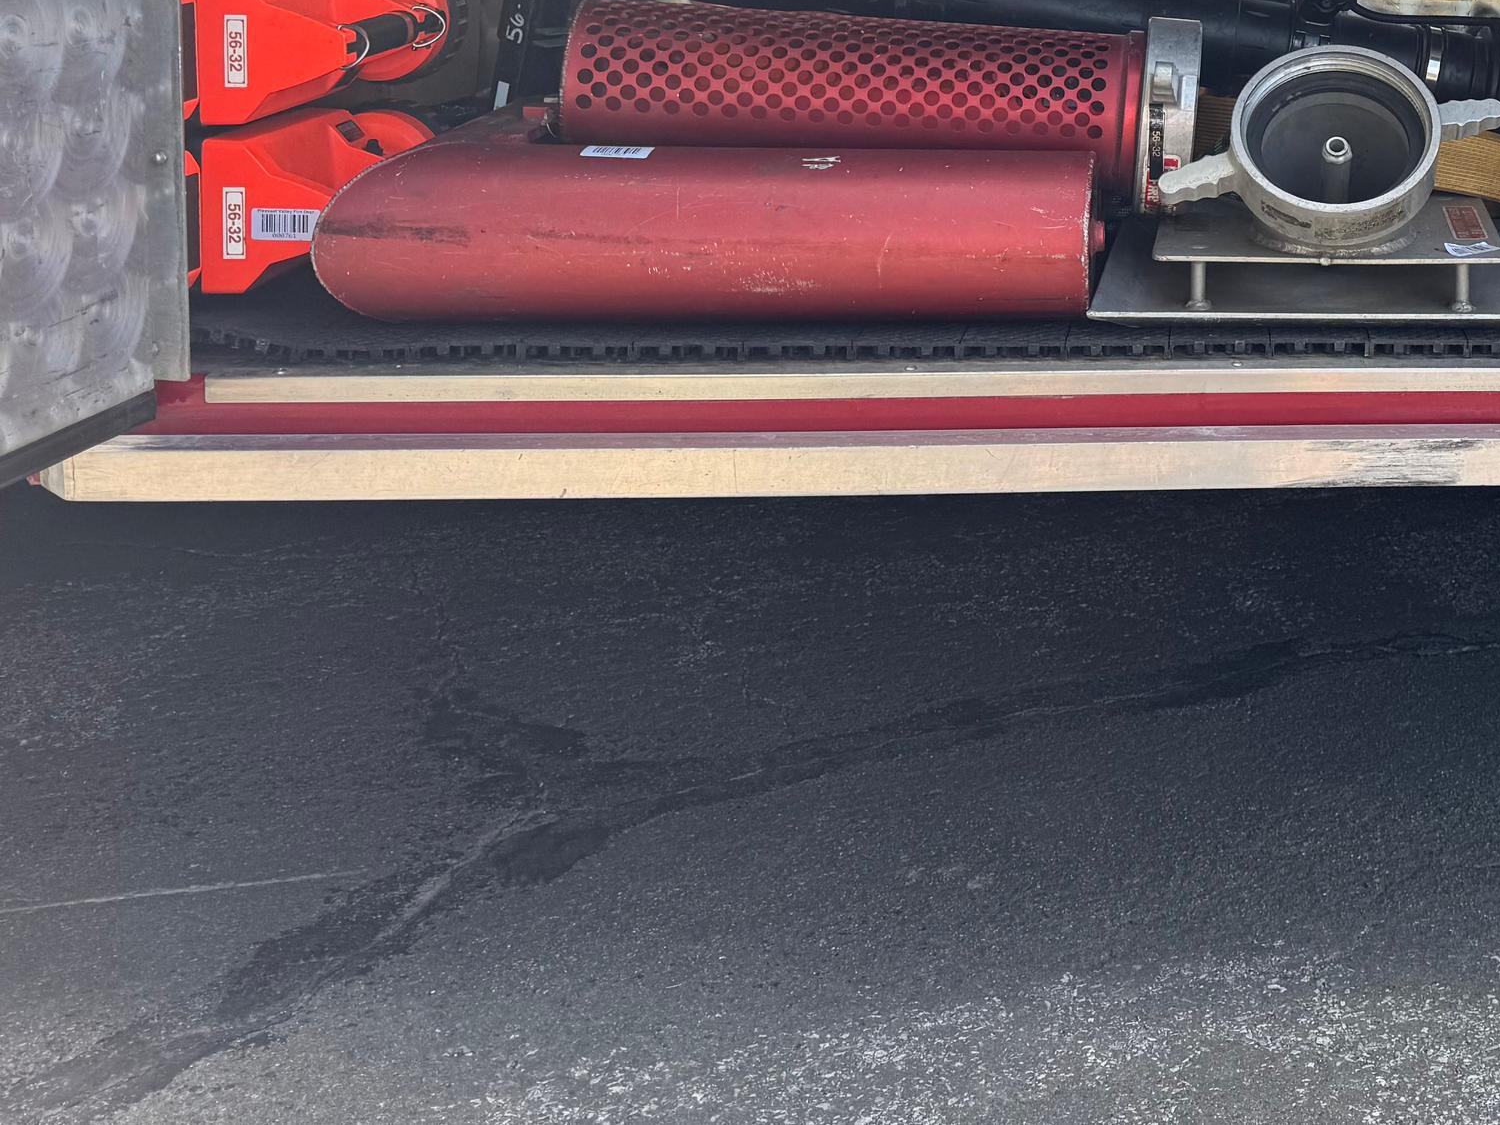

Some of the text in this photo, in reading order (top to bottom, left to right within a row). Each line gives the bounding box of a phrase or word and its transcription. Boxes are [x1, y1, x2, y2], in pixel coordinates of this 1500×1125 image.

[229, 31, 243, 72] 56-32
[1152, 130, 1161, 157] 56-32
[228, 203, 241, 244] 56-32
